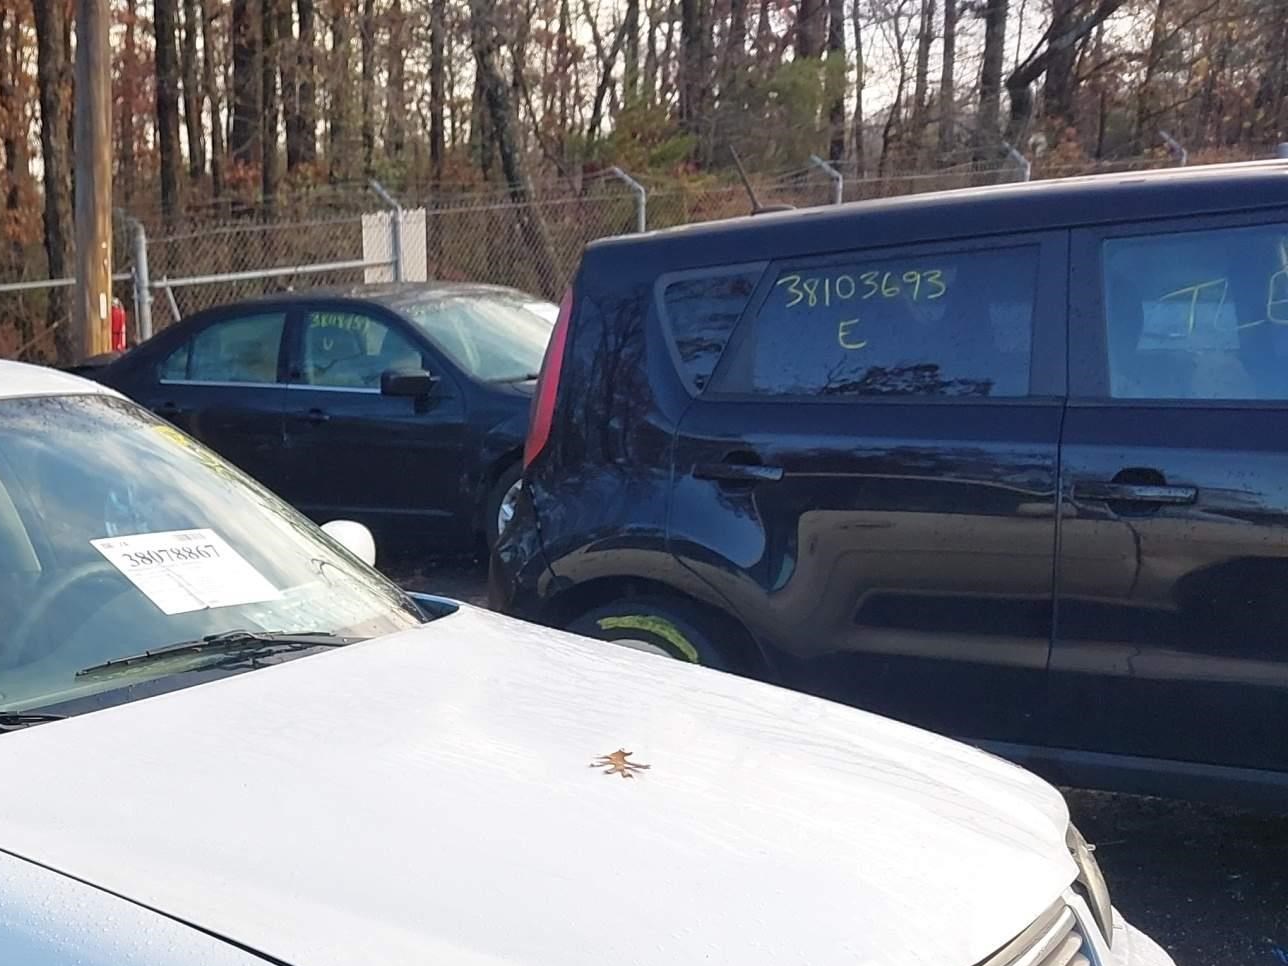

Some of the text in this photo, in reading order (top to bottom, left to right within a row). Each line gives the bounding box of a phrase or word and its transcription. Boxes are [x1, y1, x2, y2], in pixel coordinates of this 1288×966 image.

[777, 270, 946, 308] 38103693
[838, 318, 867, 349] E
[122, 544, 220, 568] 38078867
